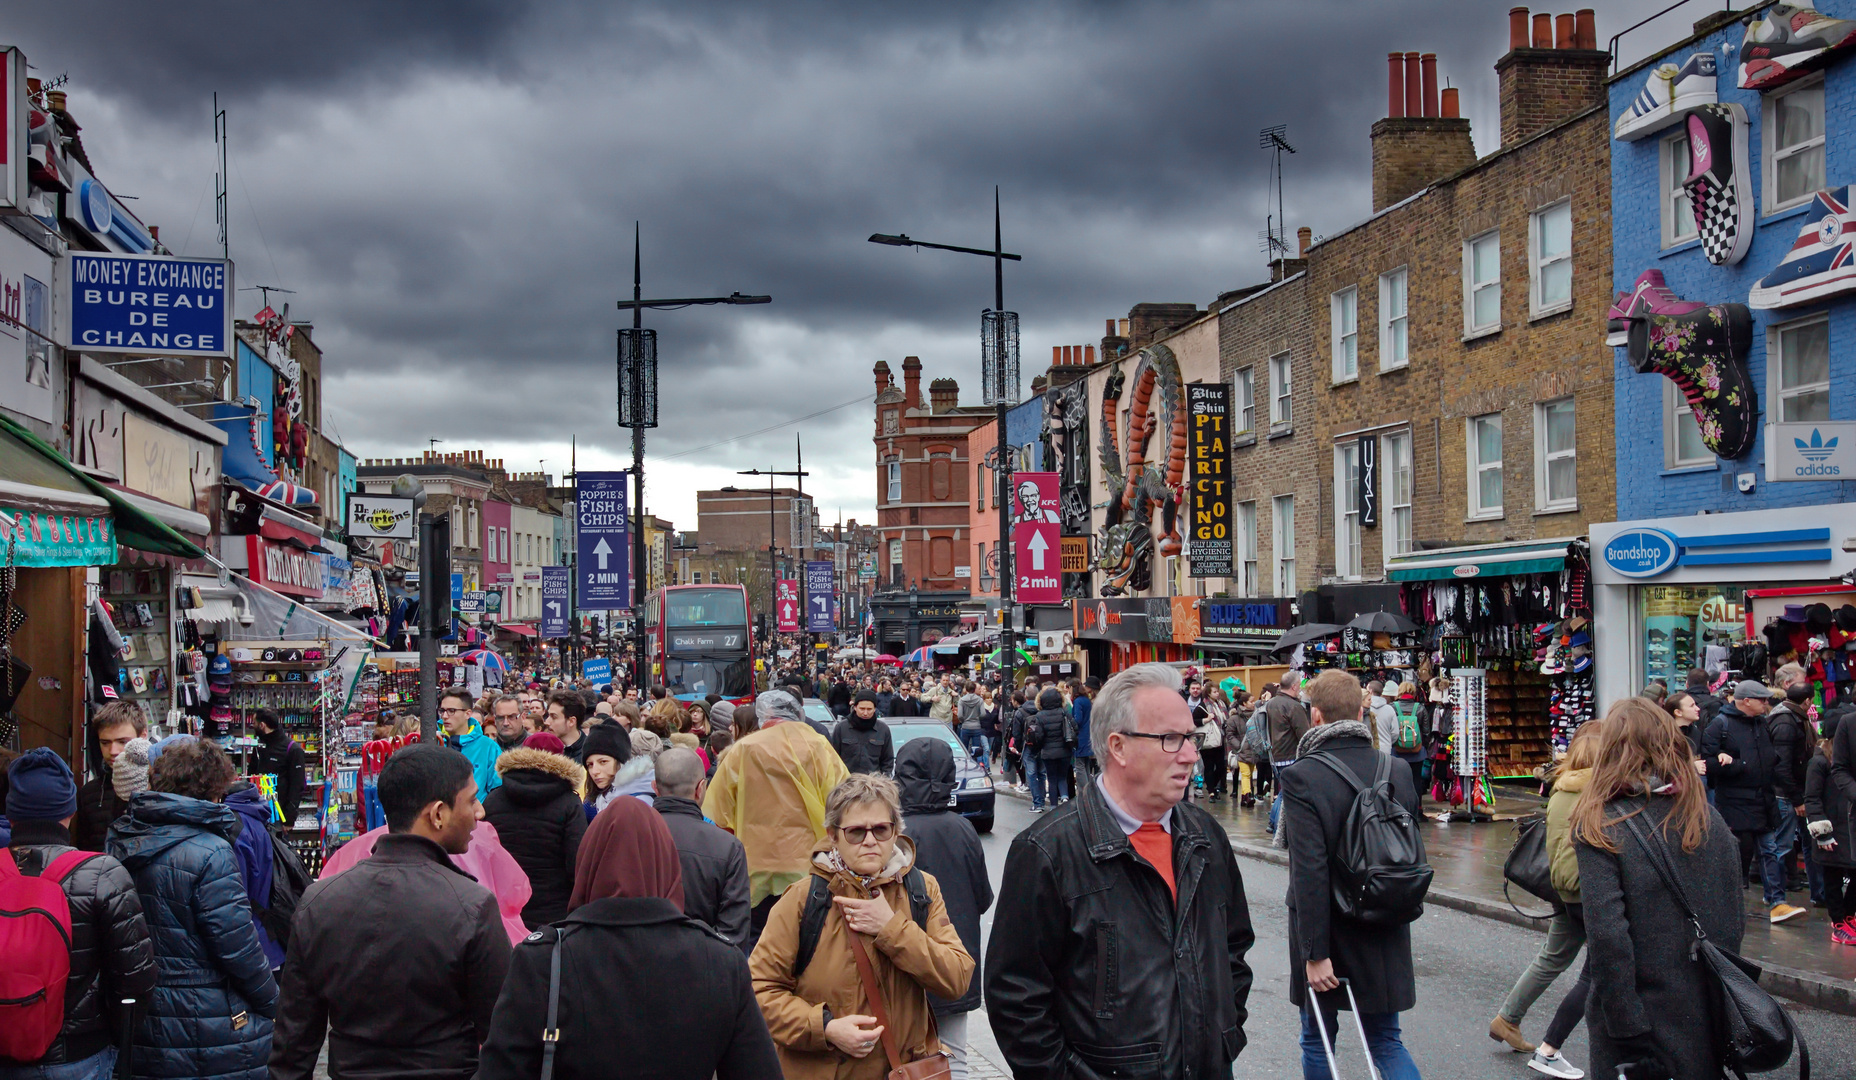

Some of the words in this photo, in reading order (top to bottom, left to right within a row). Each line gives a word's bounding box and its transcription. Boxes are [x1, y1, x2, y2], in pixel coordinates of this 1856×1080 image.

[76, 259, 131, 285] MONEY
[138, 263, 223, 289] EXCHANGE
[84, 289, 214, 309] BUREAU
[129, 312, 168, 327] DE
[82, 329, 214, 349] CHANGE
[1192, 387, 1223, 400] Blue
[1192, 401, 1225, 415] Skin
[1196, 414, 1212, 539] PIERCING
[1795, 463, 1840, 476] adidas
[1211, 416, 1226, 539] TATTOO
[580, 490, 624, 500] POPPIE'S
[354, 503, 369, 513] Dr.
[580, 500, 615, 513] FISH
[617, 503, 624, 511] &
[354, 510, 411, 524] Martens
[580, 513, 624, 526] CHIPS
[47, 514, 109, 543] BELTS
[1608, 538, 1661, 565] Brandshop
[588, 573, 595, 584] 2
[597, 573, 618, 584] MIN
[1021, 577, 1029, 588] 2
[1032, 576, 1057, 588] min
[1654, 587, 1666, 599] CAT
[1210, 604, 1243, 624] BLUE
[1244, 603, 1277, 625] SKIN
[1702, 603, 1745, 623] SALE
[725, 636, 737, 646] 27
[586, 672, 610, 680] CHANGE
